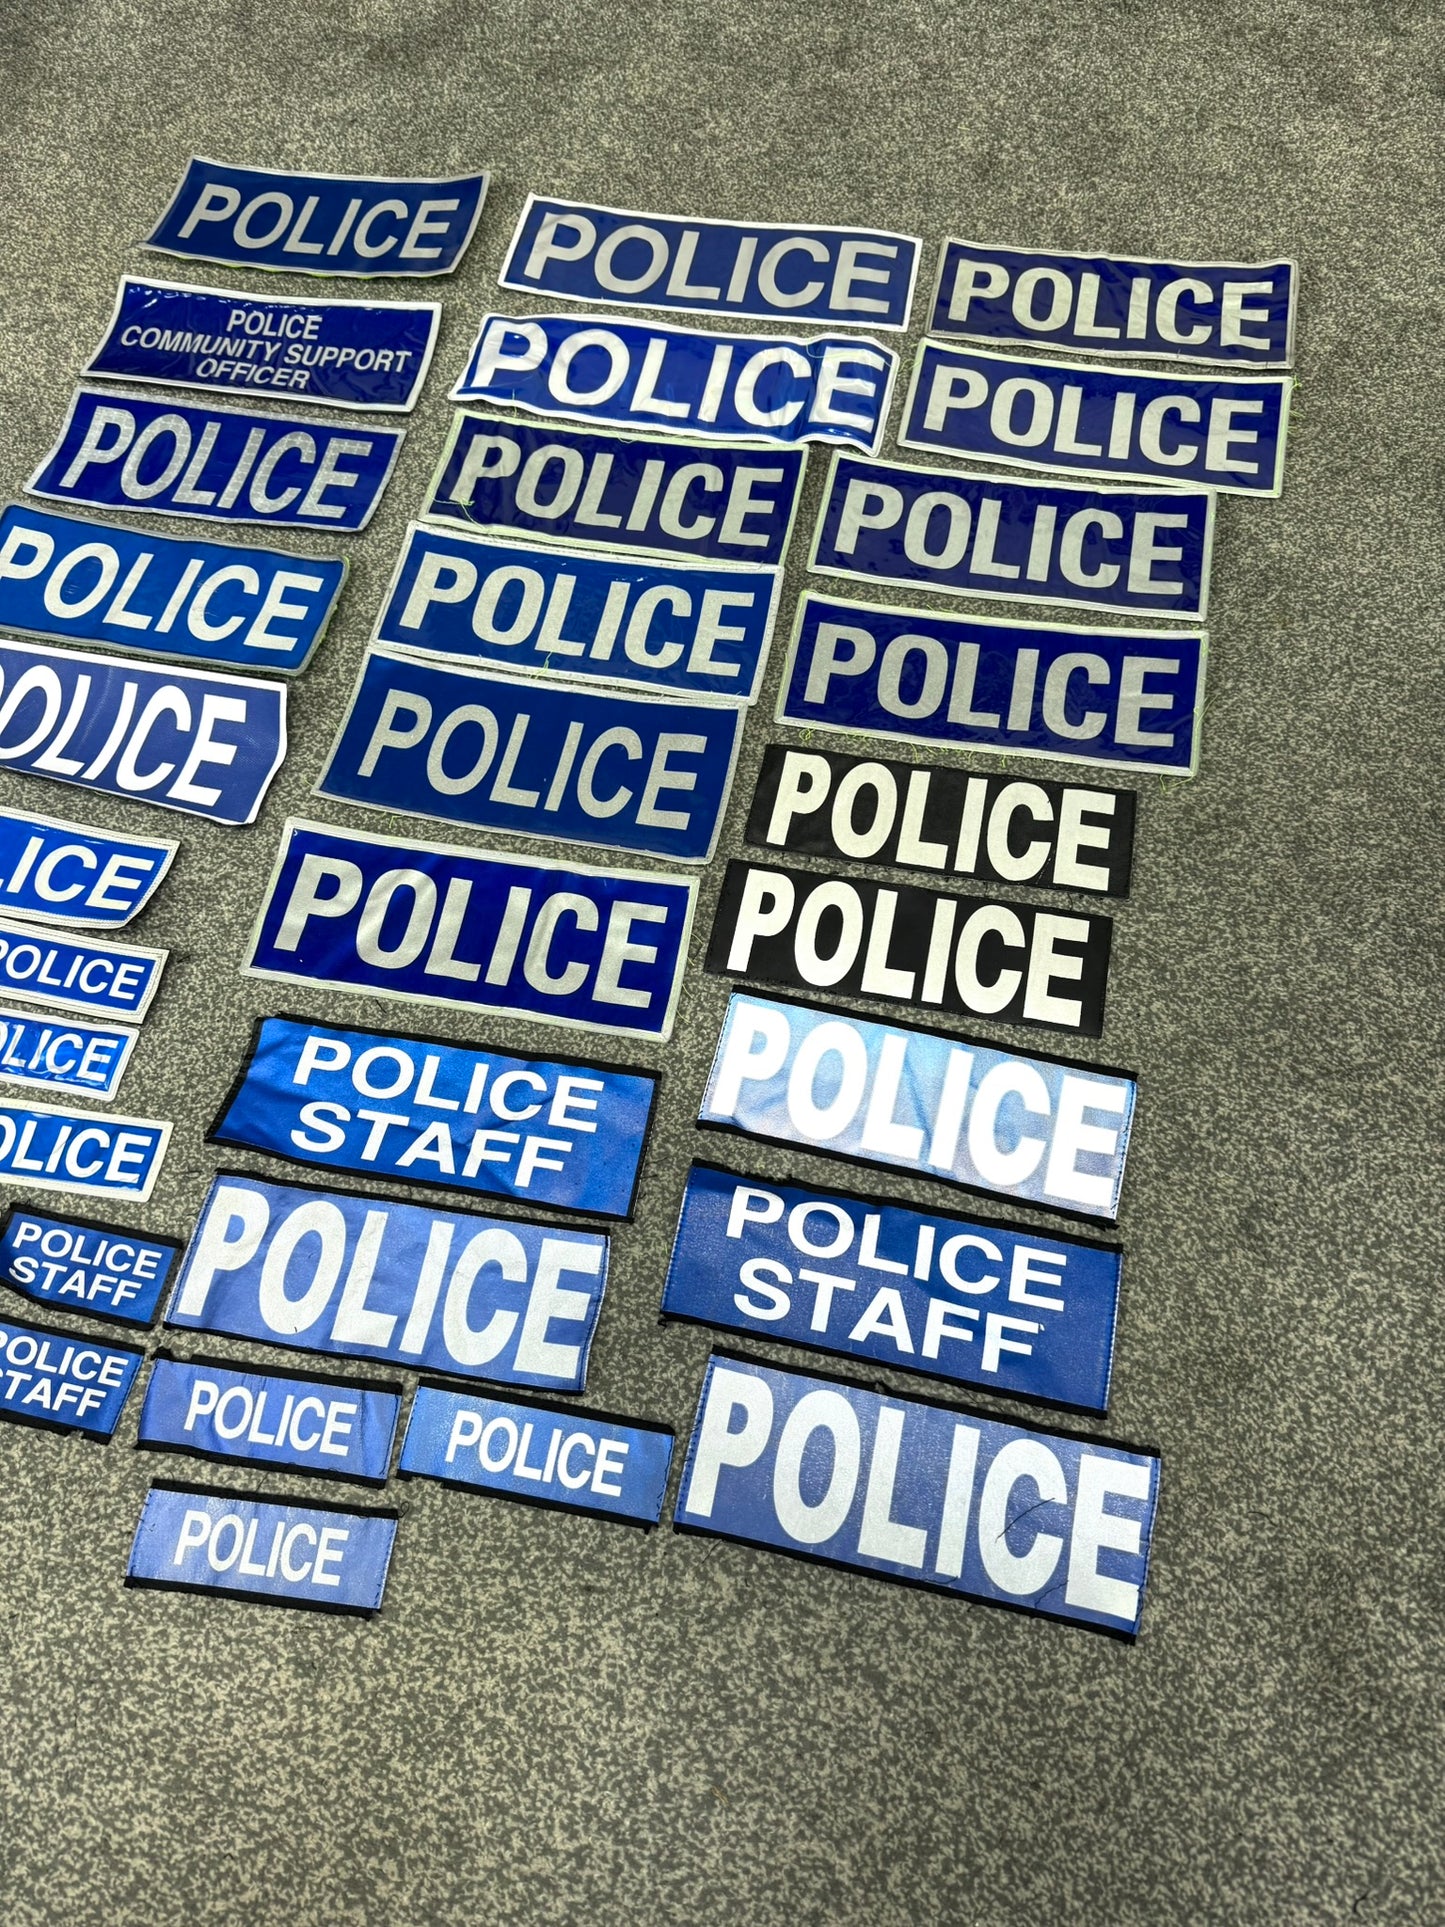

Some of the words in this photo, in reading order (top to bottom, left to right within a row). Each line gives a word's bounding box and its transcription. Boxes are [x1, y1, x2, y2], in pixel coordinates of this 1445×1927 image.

[178, 183, 461, 258] POLICE
[524, 213, 898, 313] POLICE
[121, 326, 282, 361] COMMUNITY
[284, 343, 412, 372] SUPPORT
[227, 310, 323, 339] POLICE
[947, 260, 1274, 349] POLICE
[196, 358, 310, 389] OFFICER
[470, 321, 885, 433] POLICE
[923, 364, 1264, 474] POLICE
[59, 405, 372, 517] POLICE
[449, 435, 784, 547] POLICE
[833, 479, 1190, 596] POLICE
[400, 551, 755, 676] POLICE
[0, 664, 247, 806] OLICE
[803, 623, 1181, 748] POLICE
[357, 689, 708, 830] POLICE
[0, 836, 155, 911] ICE
[766, 751, 1116, 891] POLICE
[273, 854, 668, 1008] POLICE
[727, 869, 1090, 1027] POLICE
[0, 1020, 119, 1083] LICE
[293, 1036, 605, 1132] POLICE
[708, 1002, 1126, 1208] POLICE
[291, 1102, 573, 1187] STAFF
[9, 1257, 142, 1306] STAFF
[12, 1222, 162, 1279] POLICE
[176, 1186, 605, 1379] POLICE
[726, 1186, 1067, 1311] POLICE
[733, 1258, 1040, 1372] STAFF
[0, 1369, 107, 1417] TAFF
[184, 1380, 360, 1456] POLICE
[445, 1411, 629, 1497] POLICE
[685, 1367, 1151, 1622] POLICE
[172, 1510, 348, 1586] POLICE
